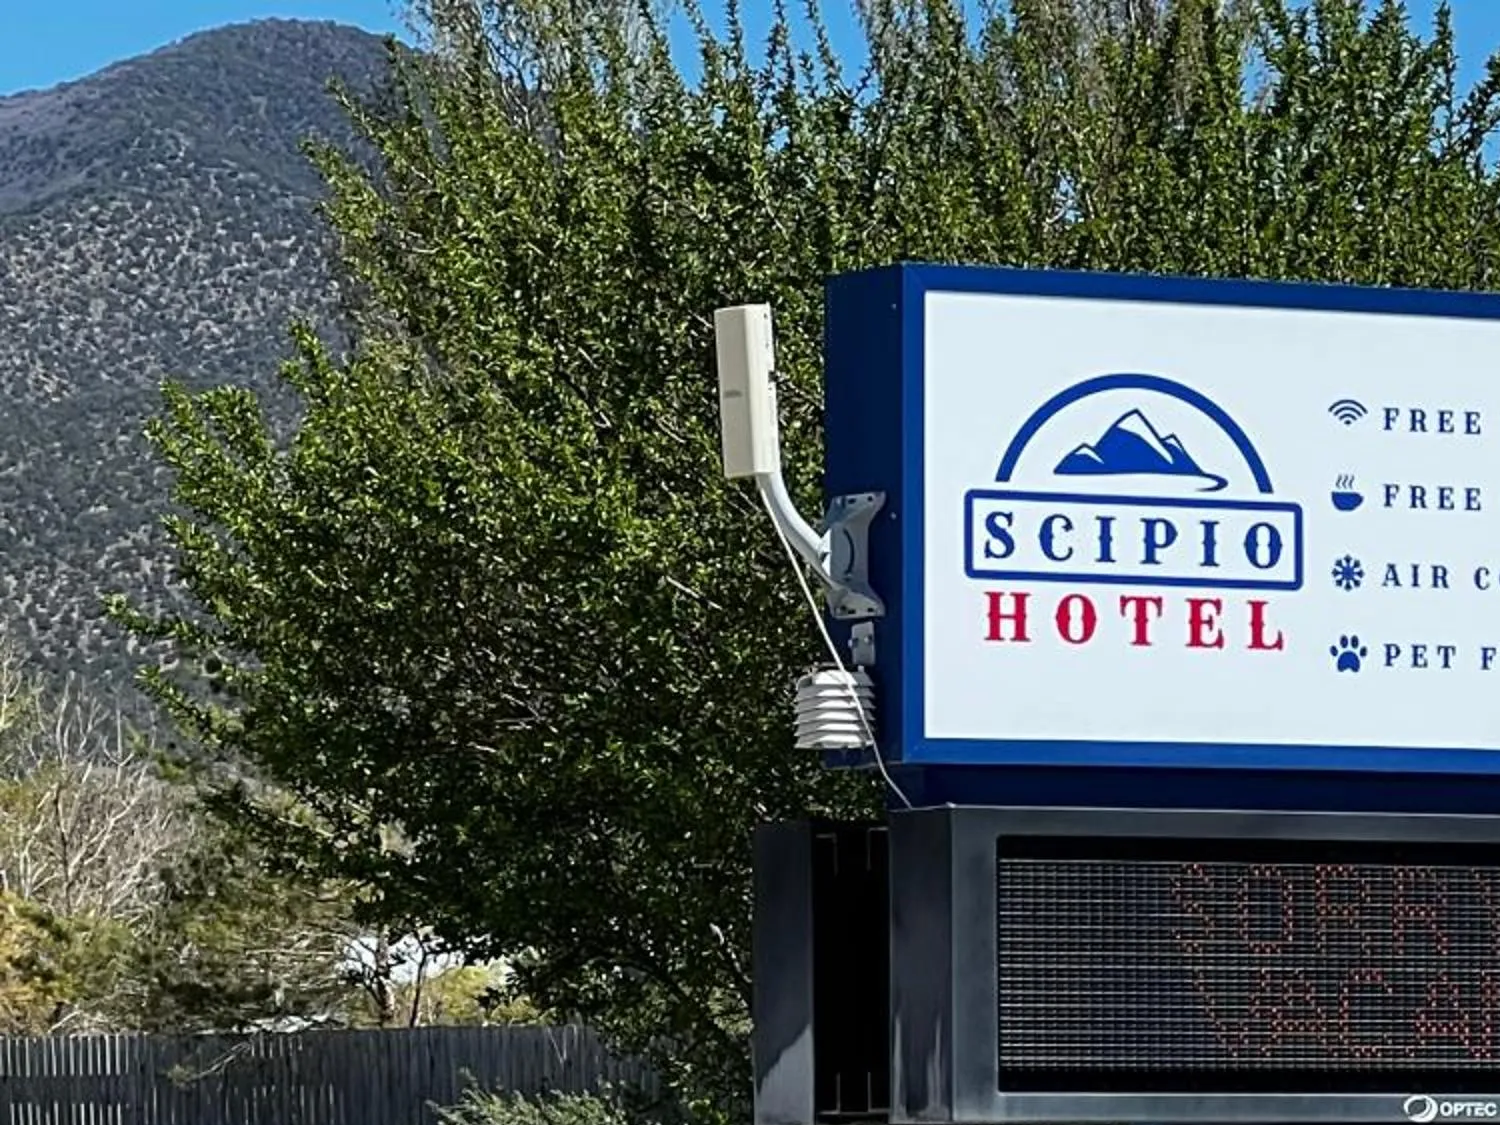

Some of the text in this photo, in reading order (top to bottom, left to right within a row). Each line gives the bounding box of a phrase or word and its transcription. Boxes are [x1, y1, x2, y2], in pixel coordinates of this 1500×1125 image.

[1383, 407, 1482, 435] FREE
[1383, 484, 1483, 512] FREE
[984, 511, 1283, 570] SCIPIO
[1382, 563, 1449, 589] AIR
[984, 591, 1284, 651] HOTEL
[1384, 643, 1456, 669] PET
[1440, 1101, 1498, 1117] OPTEC
